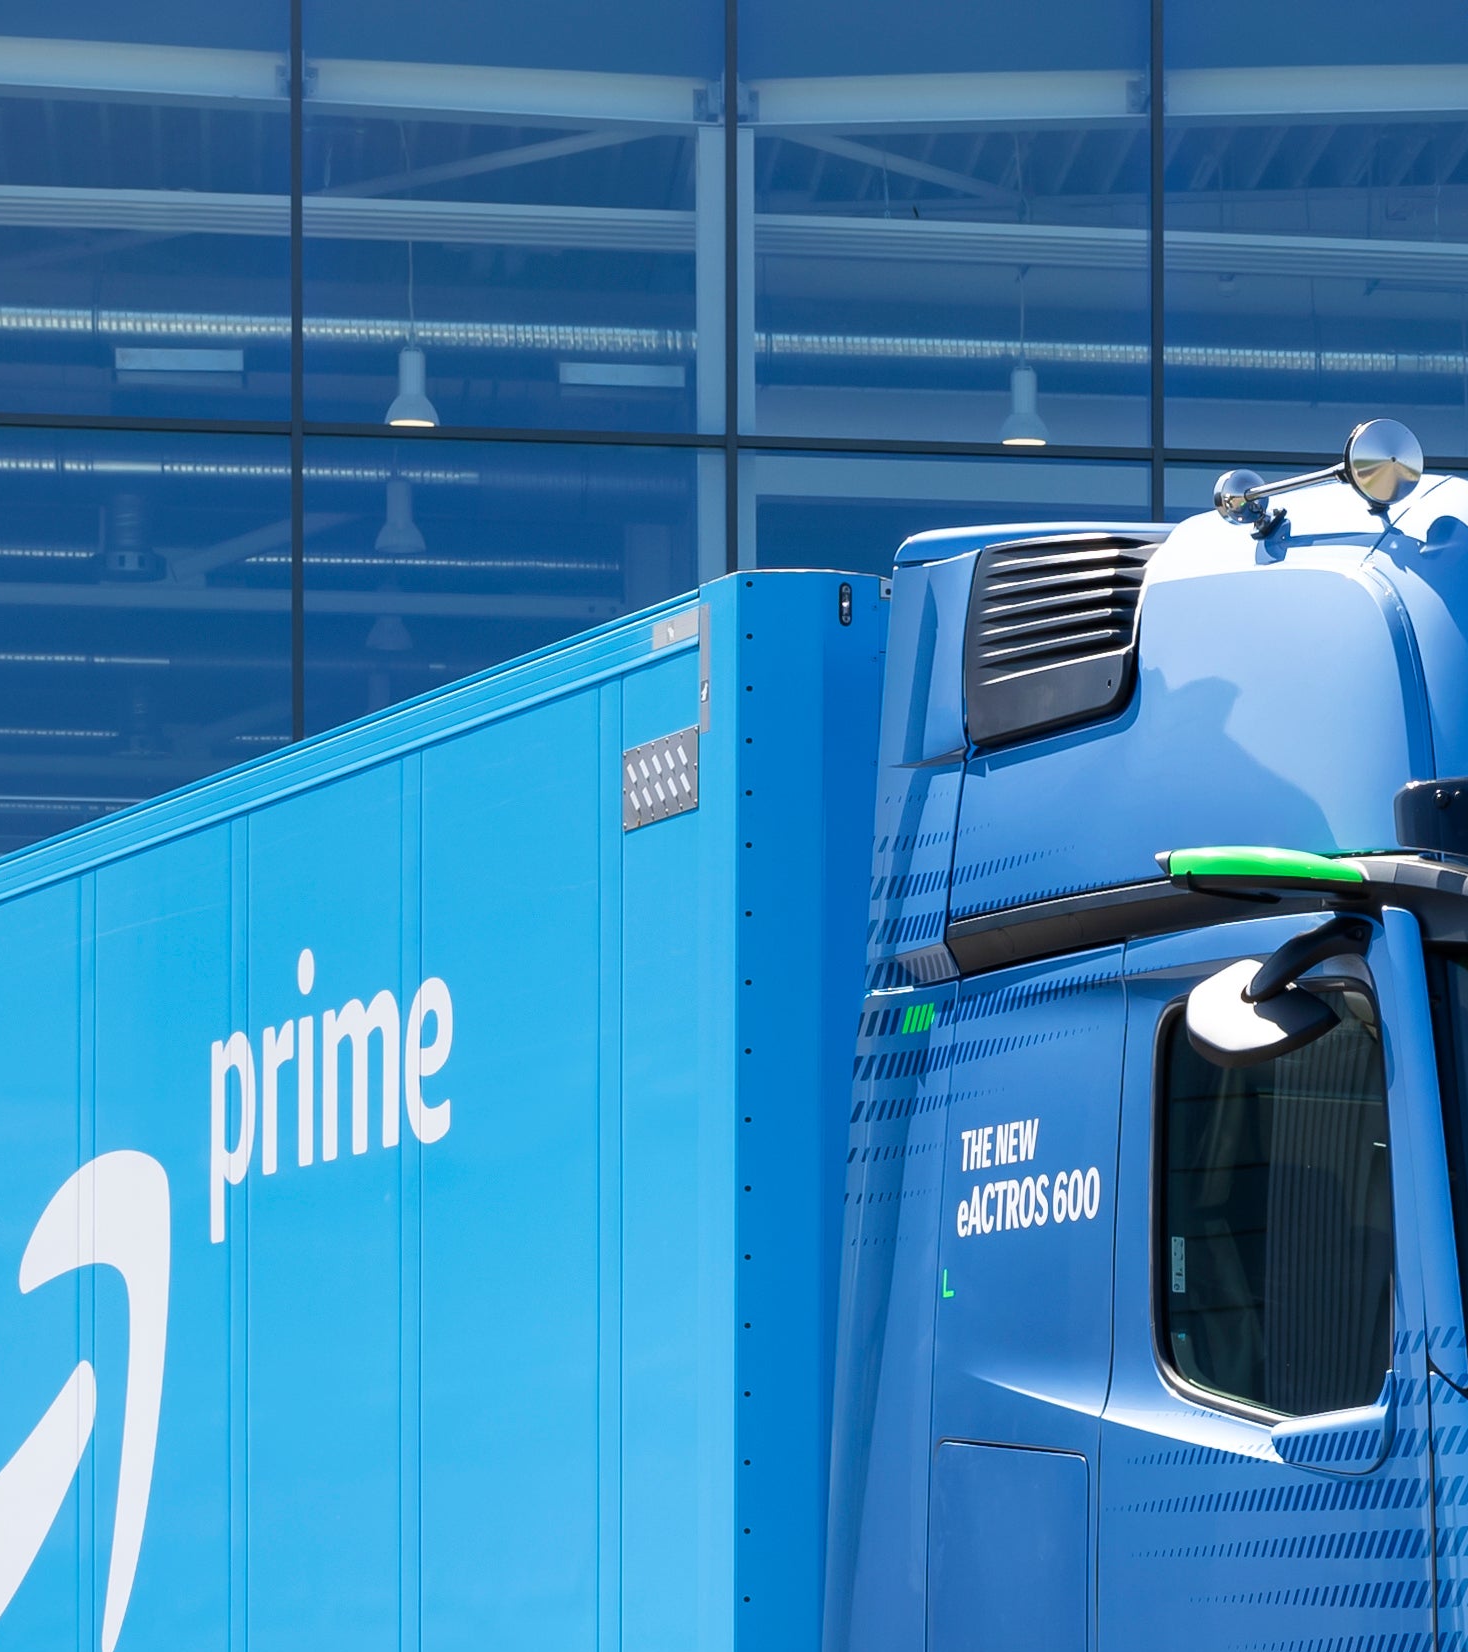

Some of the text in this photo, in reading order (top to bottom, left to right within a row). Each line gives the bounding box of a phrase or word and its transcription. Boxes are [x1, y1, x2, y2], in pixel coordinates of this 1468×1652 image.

[210, 948, 453, 1244] prime
[961, 1118, 1040, 1172] THE NEW
[956, 1166, 1101, 1238] eACTROS 600
